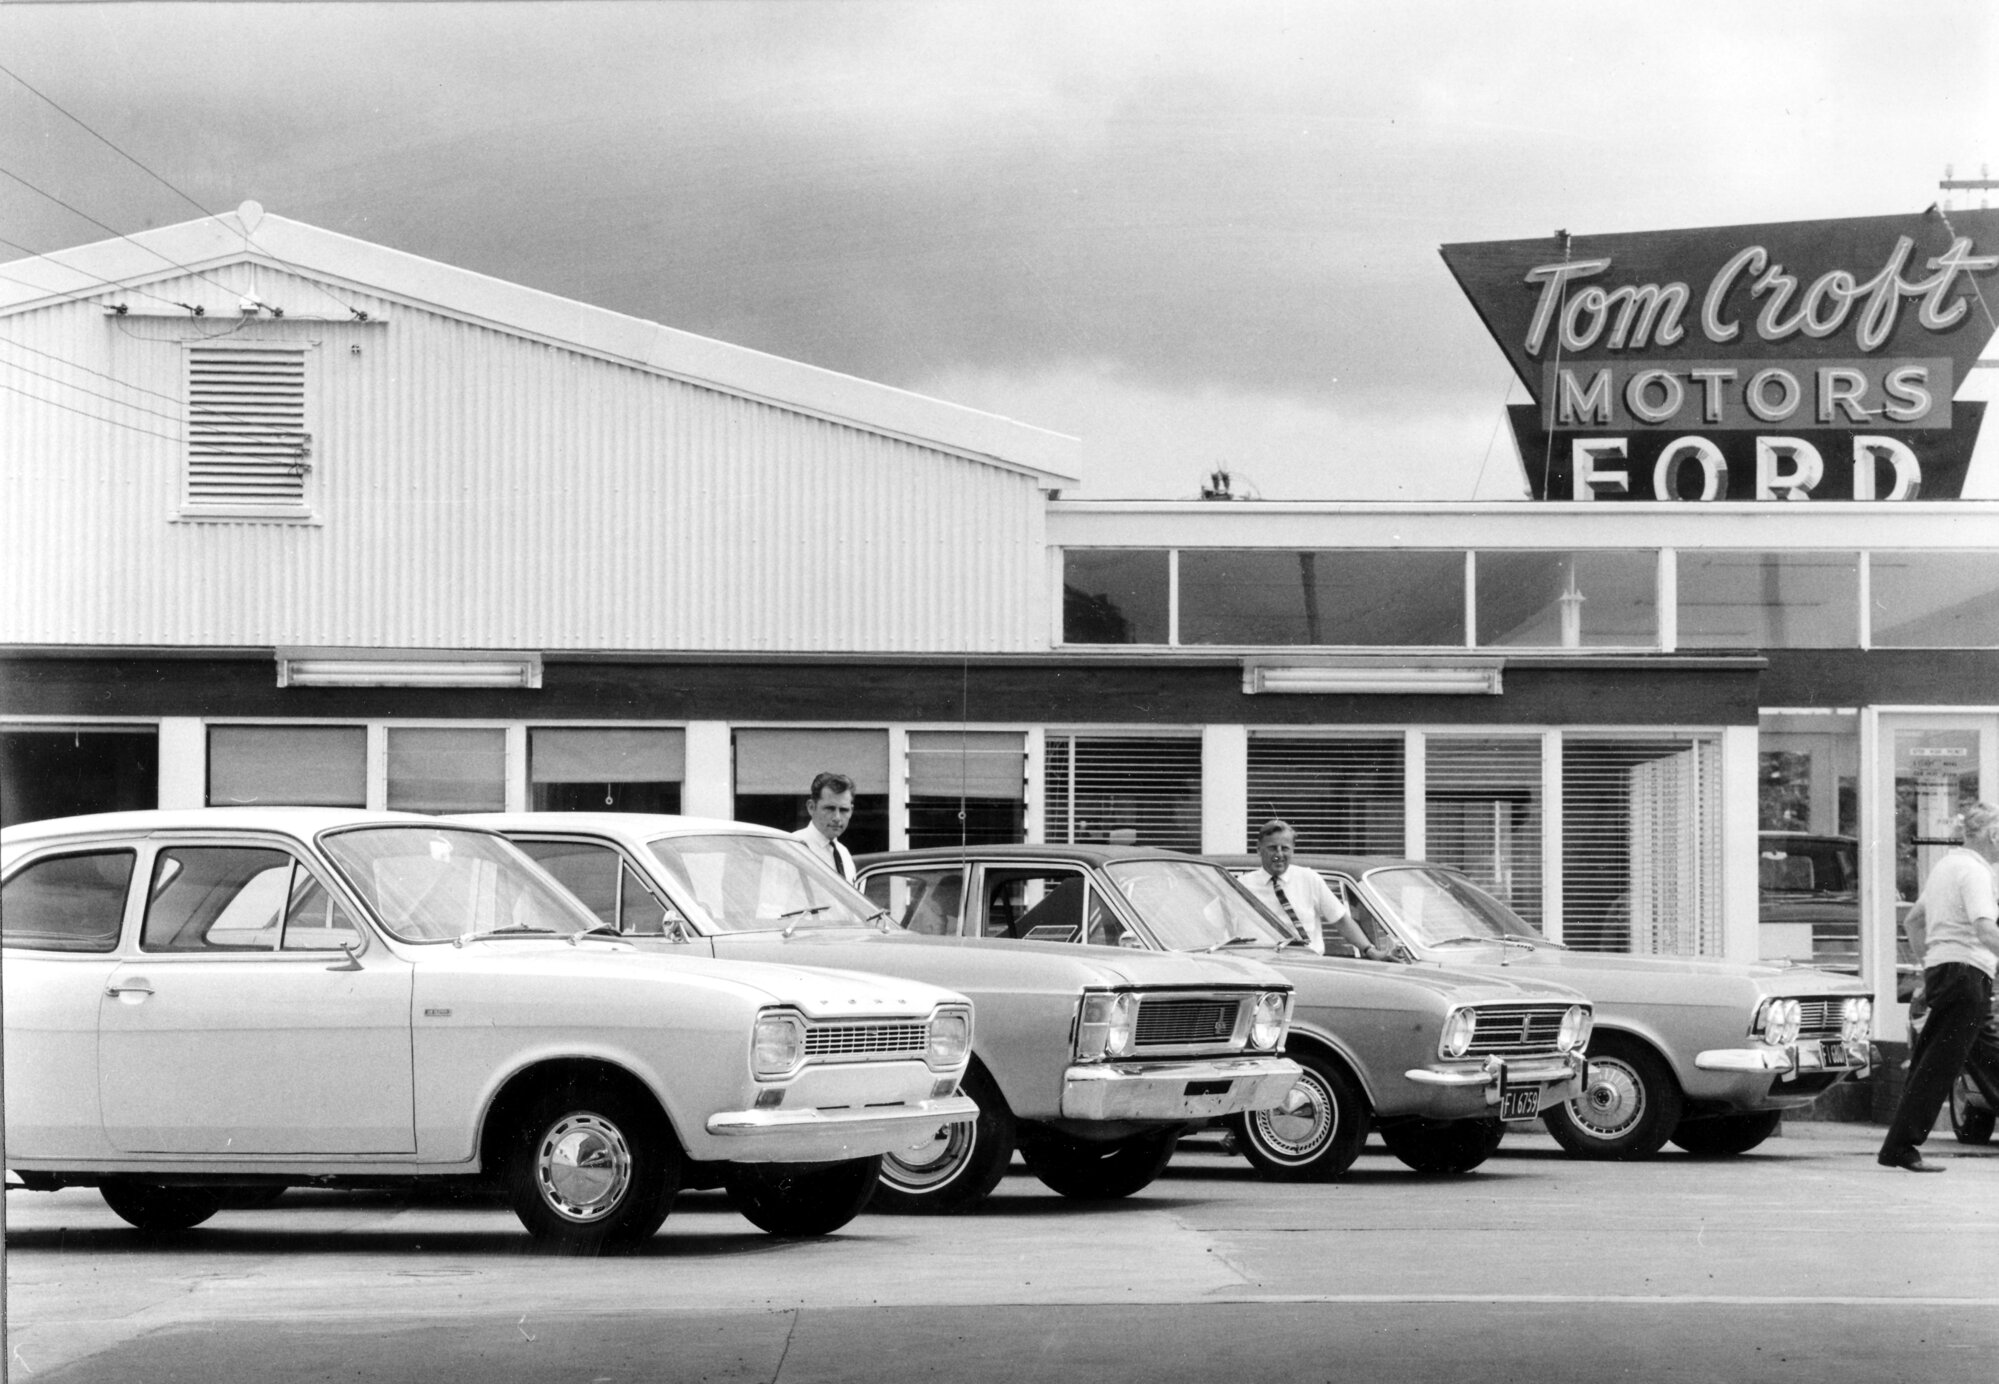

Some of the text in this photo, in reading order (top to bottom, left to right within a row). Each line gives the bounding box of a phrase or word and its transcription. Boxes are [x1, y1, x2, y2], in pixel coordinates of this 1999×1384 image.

[1524, 235, 1998, 356] Tom Croft
[1559, 366, 1932, 423] MOTORS
[1572, 435, 1922, 500] FORD
